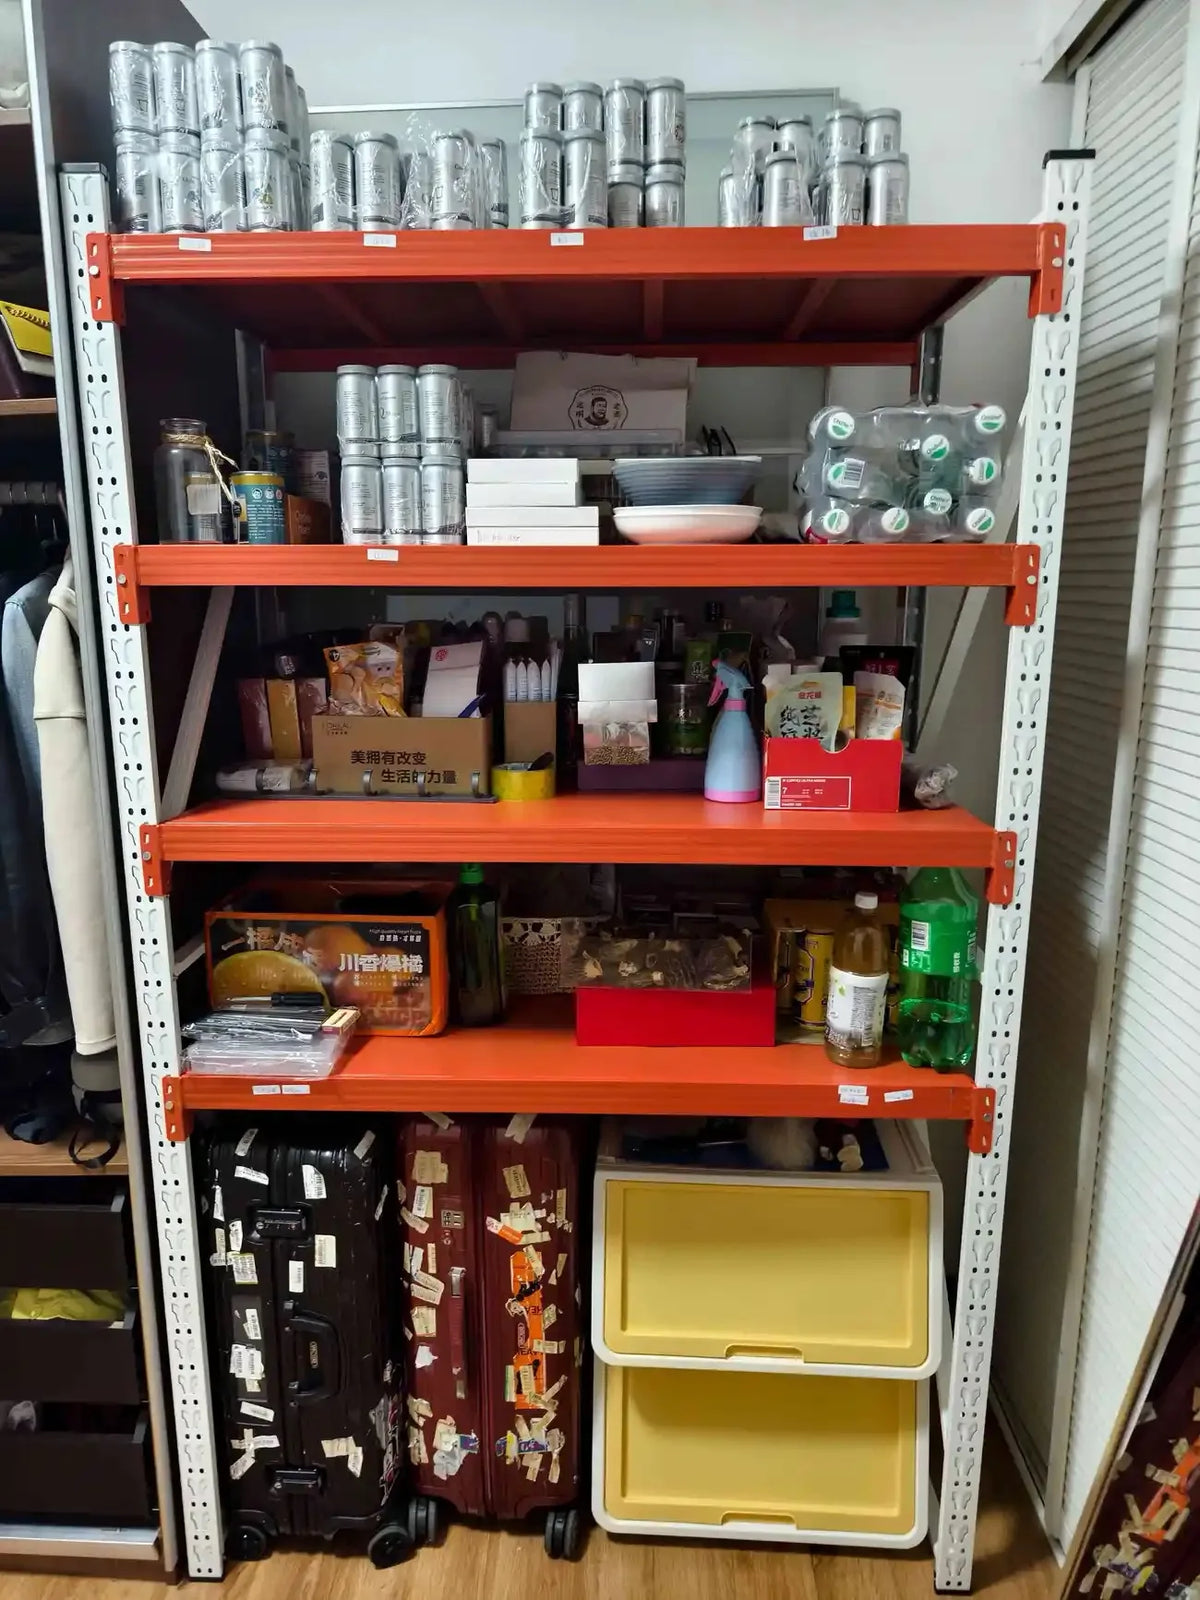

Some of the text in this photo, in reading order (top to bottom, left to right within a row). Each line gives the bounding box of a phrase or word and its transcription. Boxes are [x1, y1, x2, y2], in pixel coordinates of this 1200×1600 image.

[351, 750, 427, 765] 美拥有改变
[381, 768, 457, 784] 生活的力量
